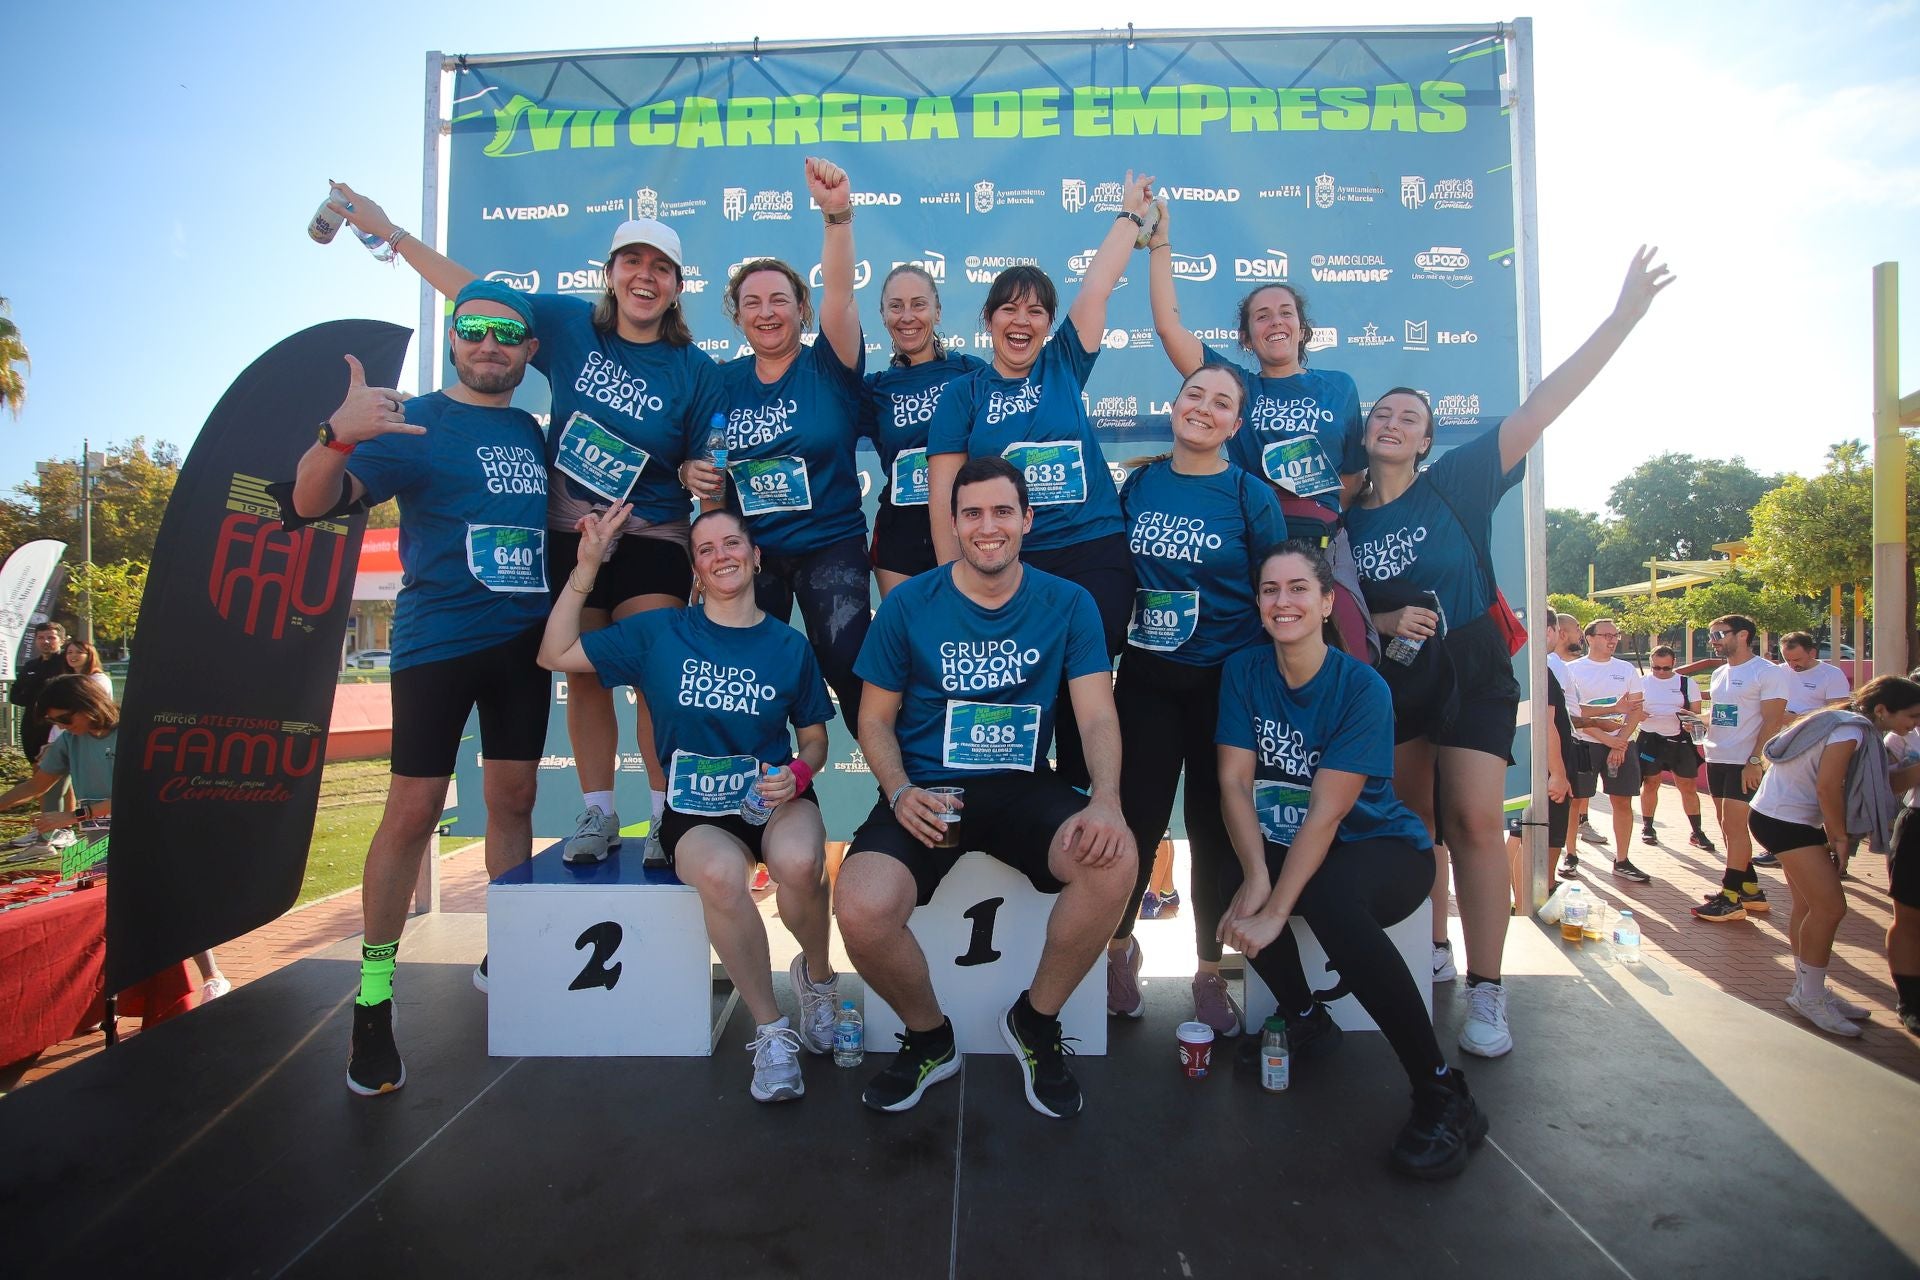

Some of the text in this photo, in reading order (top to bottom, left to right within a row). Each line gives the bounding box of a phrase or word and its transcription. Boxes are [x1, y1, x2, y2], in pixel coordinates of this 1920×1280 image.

[629, 92, 960, 150] CARRERA
[973, 86, 1061, 139] DE
[1073, 81, 1467, 138] EMPRESAS
[996, 189, 1045, 199] Ayuntamiento
[1094, 186, 1124, 196] murci
[1171, 187, 1240, 202] VERDAD
[1337, 186, 1385, 195] Ayuntamiento
[1429, 191, 1473, 200] ATLETISMO
[1434, 183, 1473, 193] murcia
[660, 199, 707, 210] Ayuntamiento
[748, 202, 793, 211] ATLETISMO
[753, 194, 793, 204] murcia
[997, 197, 1034, 206] de Murcia
[1089, 195, 1124, 203] ATLETIS
[1337, 194, 1373, 203] de Murcia
[482, 203, 570, 221] LA VERDAD
[660, 207, 696, 217] de Murcia
[982, 256, 1040, 268] AMC GLOBAL
[1235, 258, 1288, 277] DSM
[1327, 255, 1386, 266] AMC GLOBAL
[1452, 274, 1473, 282] familia
[941, 335, 965, 348] ero
[1193, 327, 1239, 340] calsa
[1347, 335, 1395, 344] ESTRELLA
[1437, 330, 1478, 344] Hero
[696, 338, 729, 351] alsa
[588, 350, 647, 392] GRUPO
[580, 362, 663, 412] HOZONO
[574, 377, 644, 421] GLOBAL
[1096, 400, 1136, 410] murcia
[1256, 394, 1317, 409] GRUPO
[1438, 398, 1479, 408] murcia
[1091, 408, 1138, 417] ATLETISMO
[1150, 402, 1172, 415] LA
[1251, 407, 1334, 423] HOZONO
[1433, 406, 1480, 416] ATLETISMO
[726, 420, 793, 450] GLOBAL
[476, 446, 536, 463] GRUPO
[573, 437, 626, 480] 1072
[482, 461, 548, 481] HOZONO
[1024, 463, 1066, 483] 633
[1277, 453, 1327, 480] 1071
[487, 477, 547, 495] GLOBAL
[749, 472, 789, 492] 632
[240, 503, 280, 519] 1925
[1137, 511, 1205, 532] GRUPO
[1132, 524, 1222, 550] HOZONO
[1353, 526, 1408, 559] GRUPO
[494, 546, 534, 567] 640
[1129, 540, 1203, 564] GLOBAL
[1142, 608, 1178, 628] 630
[940, 639, 1017, 658] GRUPO
[683, 658, 756, 683] GRUPO
[941, 648, 1040, 675] HOZONO
[680, 673, 776, 701] HOZONO
[942, 667, 1027, 692] GLOBAL
[678, 690, 760, 716] GLOBAL
[153, 713, 280, 730] murcia ATLETISMO
[970, 724, 1016, 744] 638
[143, 726, 321, 777] FAMU
[834, 762, 871, 770] ESTREL
[158, 775, 294, 804] Corriendo
[688, 772, 745, 794] 1070
[1270, 804, 1308, 825] 107
[63, 835, 110, 874] CARRE
[955, 896, 1004, 967] 1
[567, 920, 623, 992] 2
